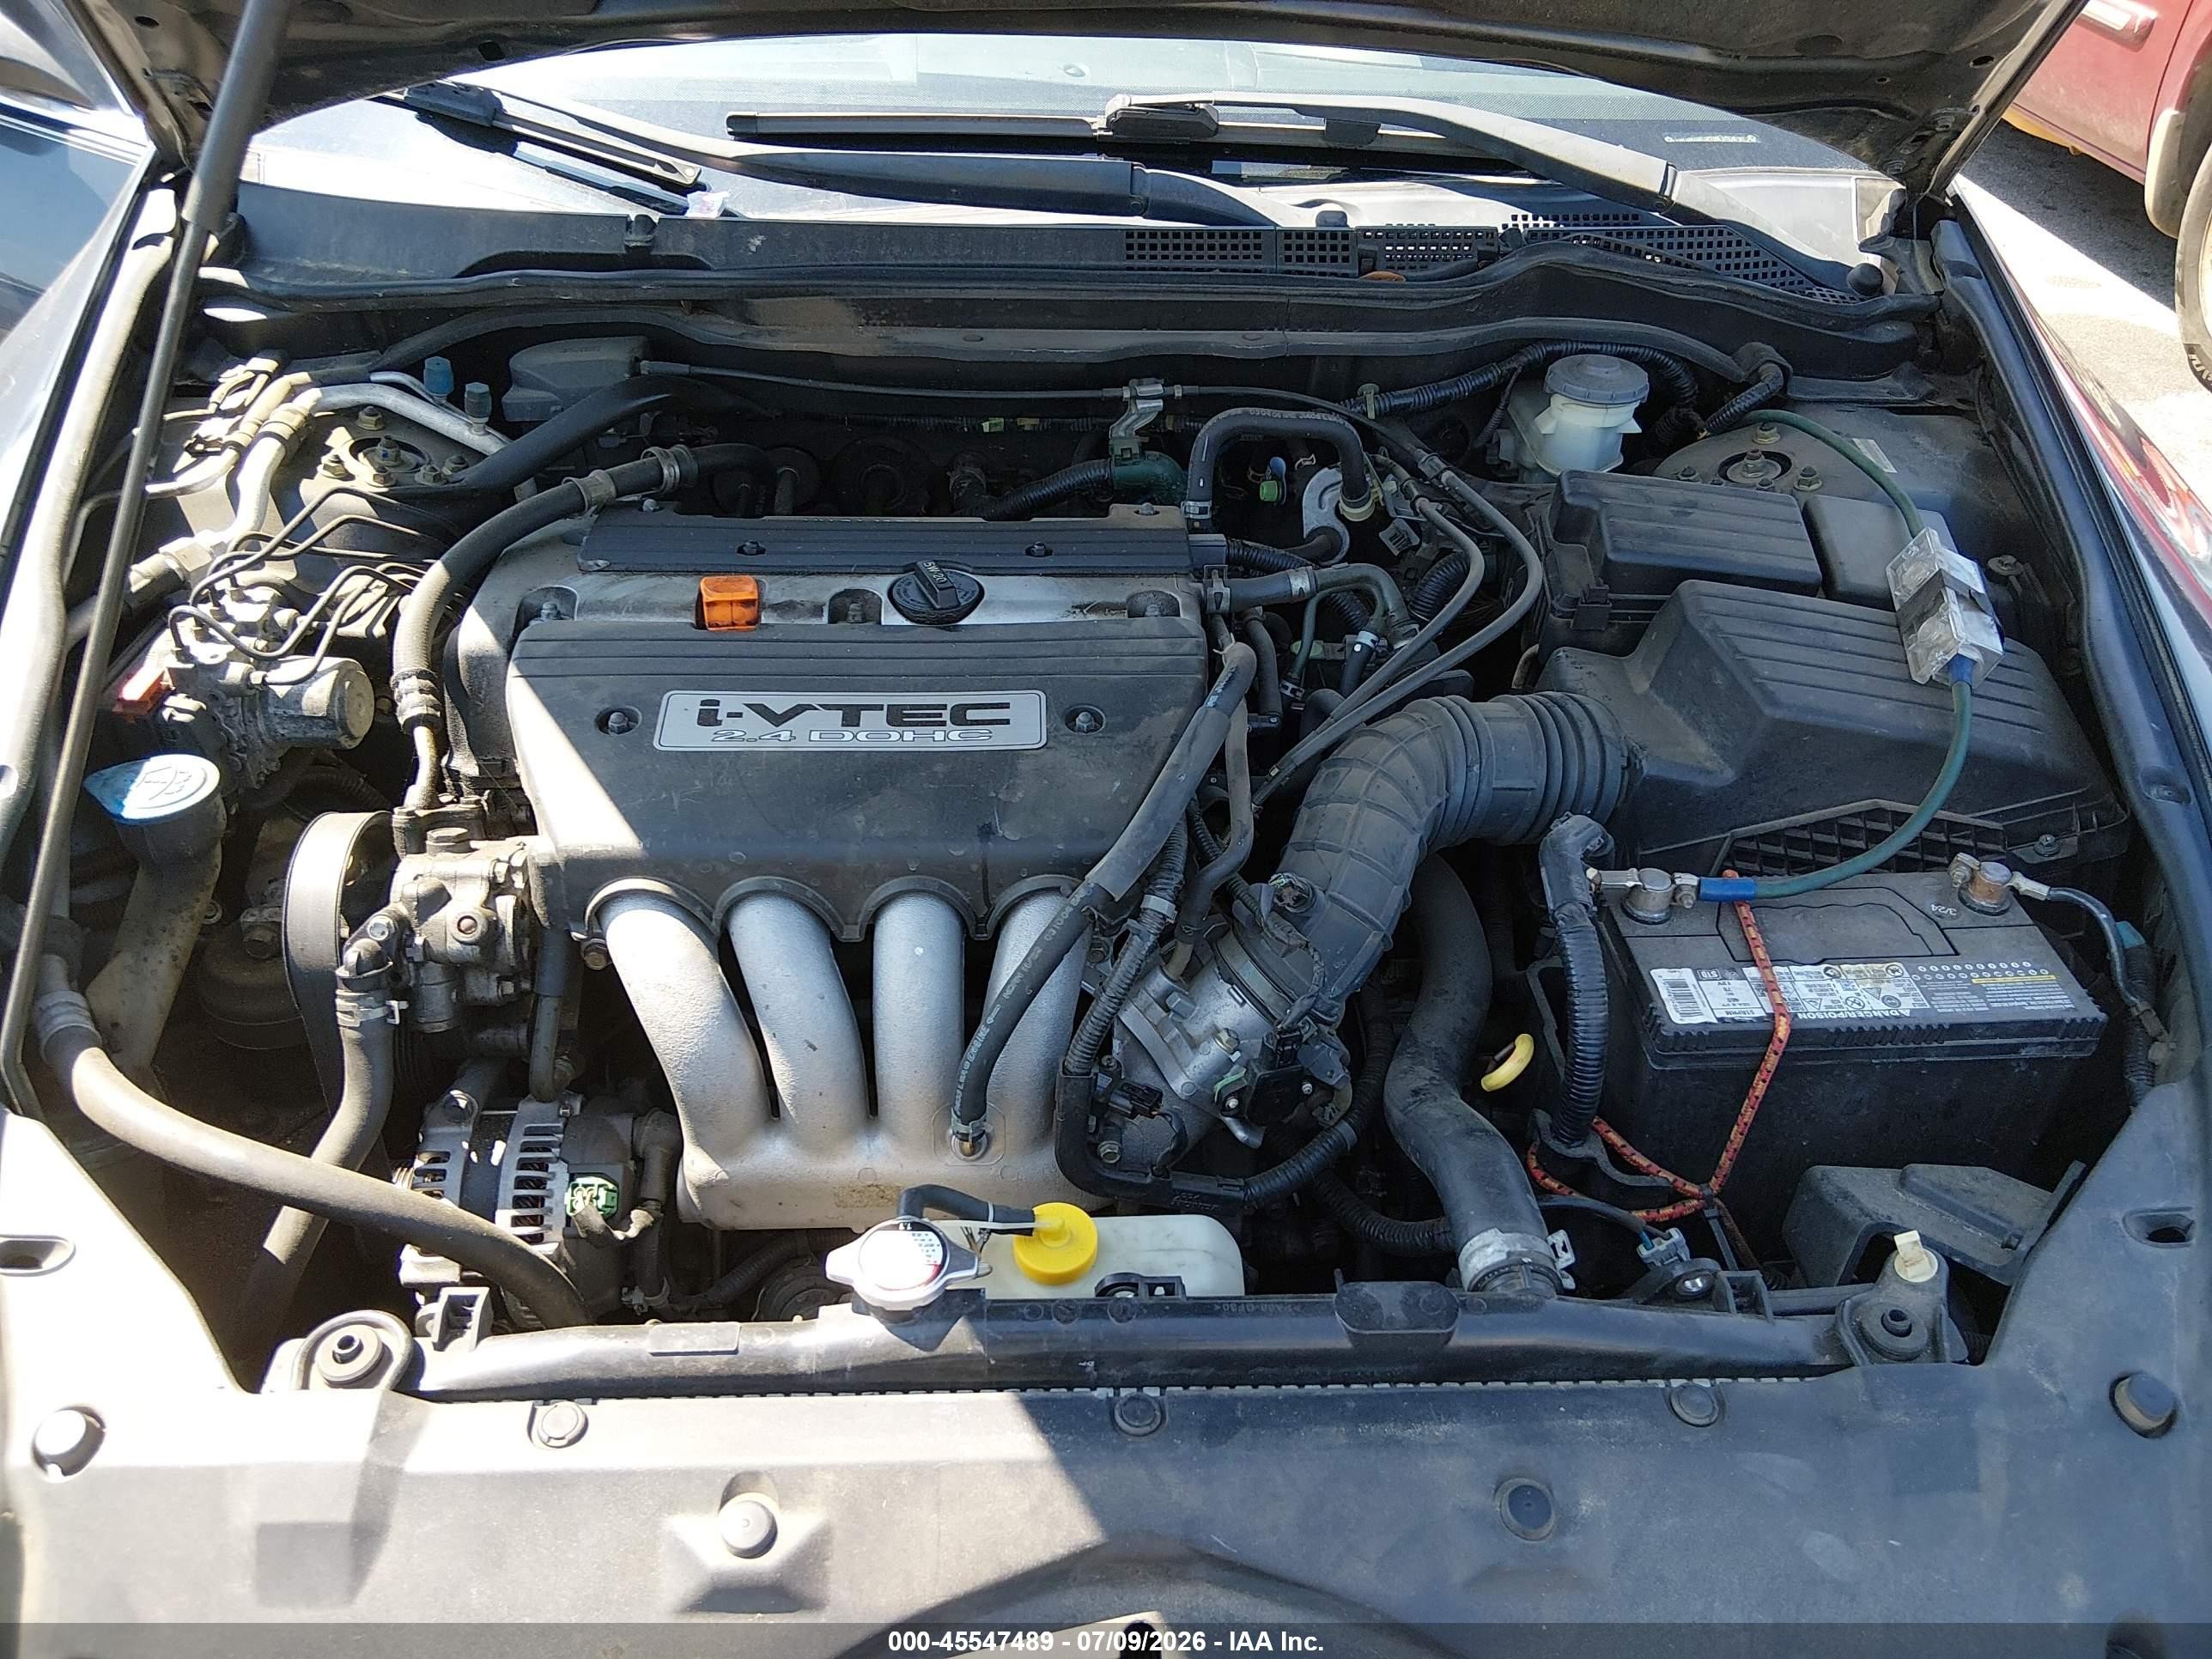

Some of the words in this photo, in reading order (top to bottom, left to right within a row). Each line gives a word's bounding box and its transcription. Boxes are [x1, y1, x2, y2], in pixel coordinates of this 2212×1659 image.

[696, 698, 1011, 728] i-VTEC
[712, 729, 796, 743] 2.4
[808, 729, 993, 743] DOHC
[1796, 1009, 1900, 1020] DANGER/POISON
